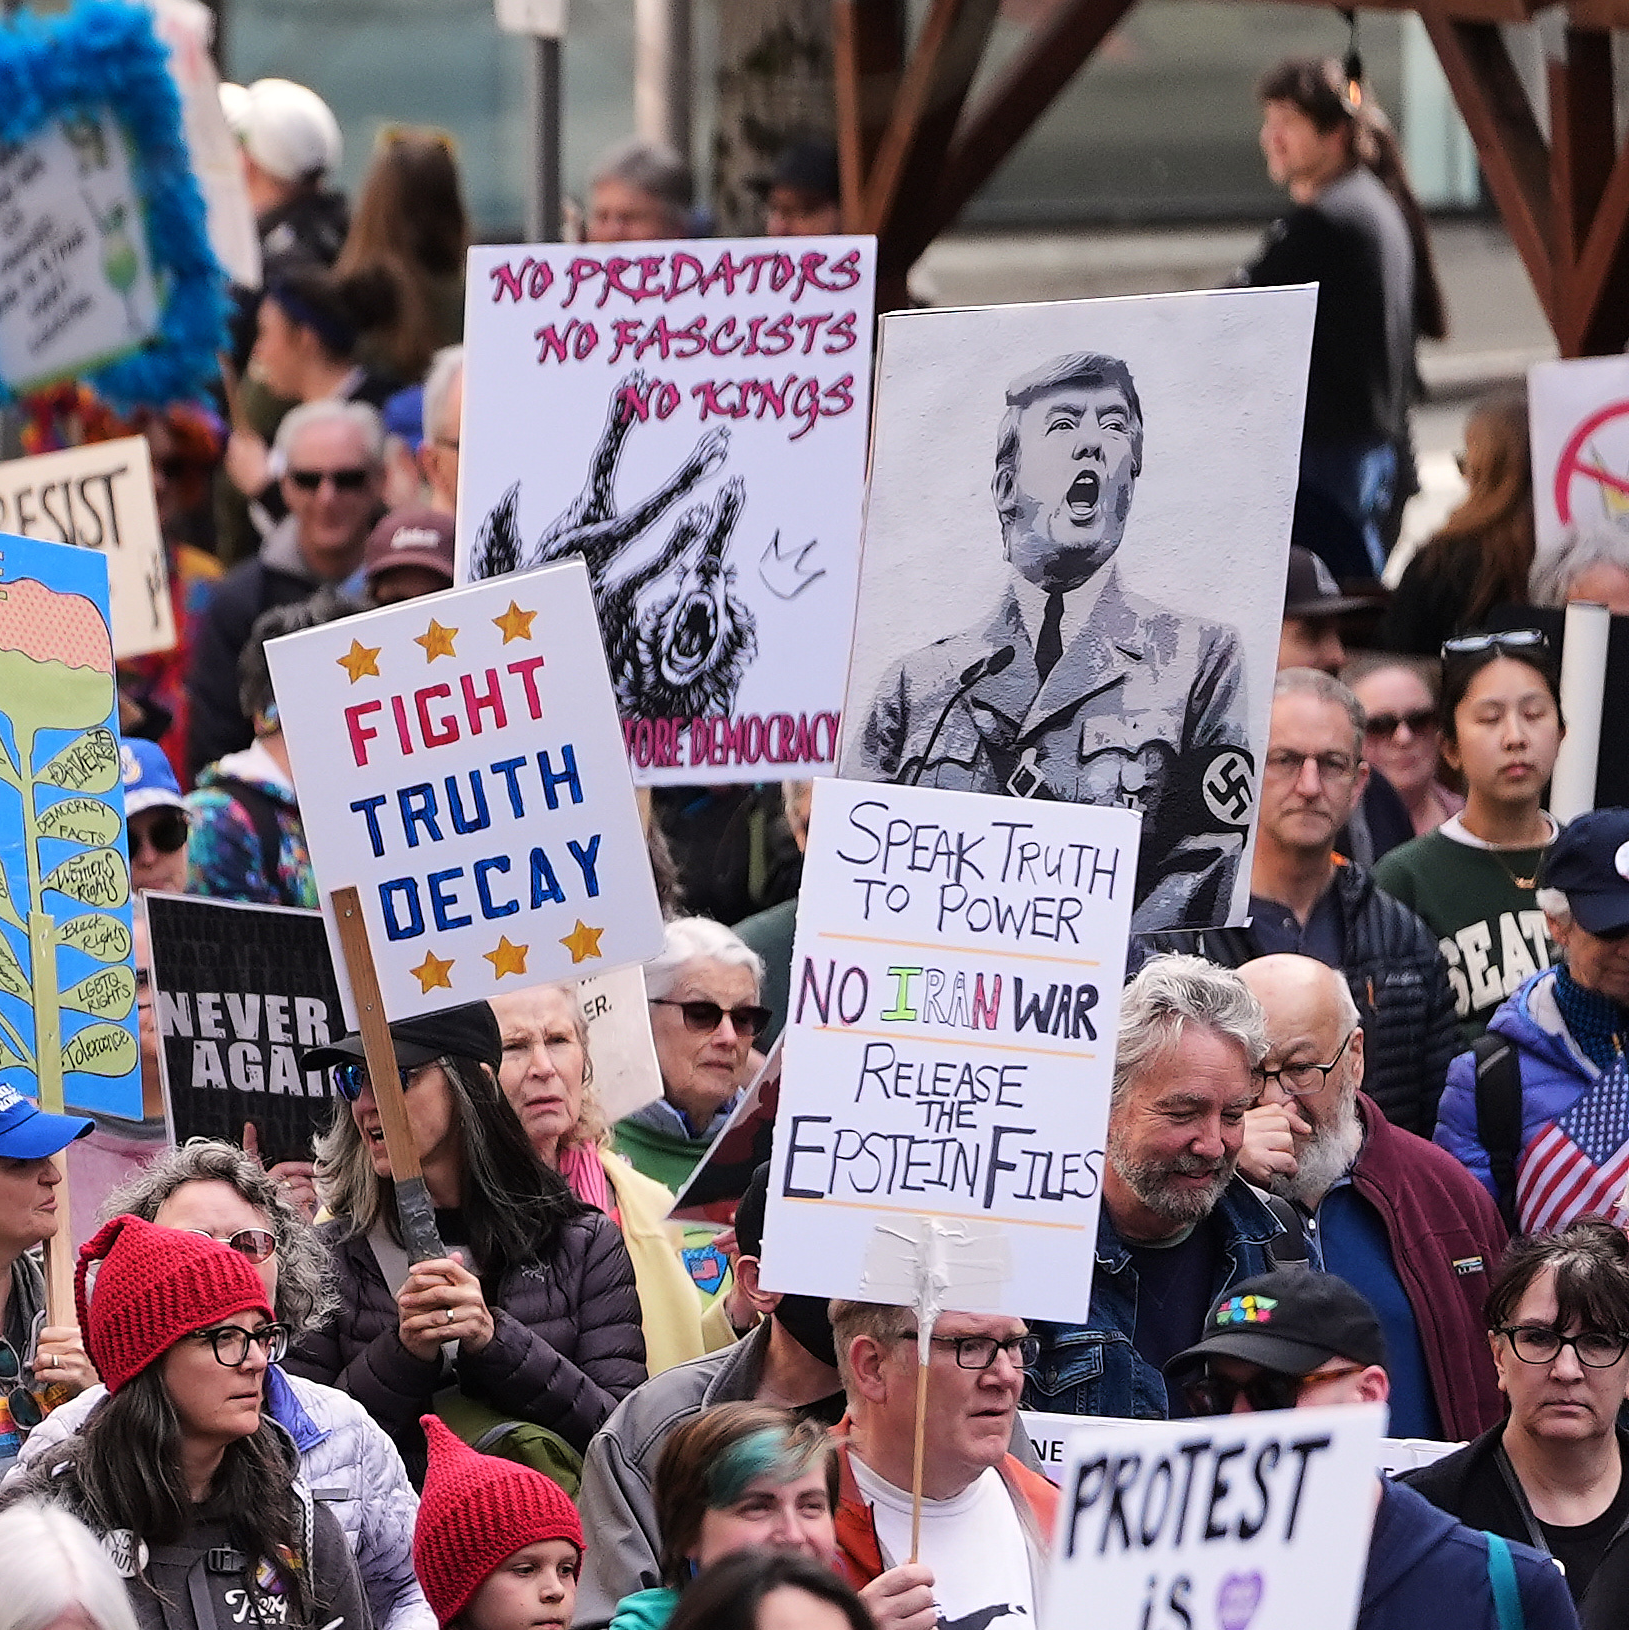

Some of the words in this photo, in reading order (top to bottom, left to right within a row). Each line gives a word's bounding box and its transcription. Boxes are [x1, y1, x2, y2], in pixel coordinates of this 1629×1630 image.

[490, 255, 554, 303] NO
[561, 248, 862, 309] PREDATORS
[534, 317, 599, 365] NO
[607, 310, 859, 365] FASCISTS
[616, 374, 681, 424] NO
[691, 373, 855, 443] KINGS
[343, 654, 547, 769] FIGHT
[690, 709, 841, 767] DEMOCRACY
[37, 803, 107, 834] DEMOCRACY
[348, 741, 585, 858] TRUTH
[59, 825, 106, 845] FACTS
[835, 800, 991, 886] SPEAK
[990, 820, 1122, 902] TRUTH
[377, 832, 603, 944] DECAY
[852, 876, 912, 922] TO
[935, 880, 1085, 946] POWER
[61, 916, 105, 940] Black
[82, 926, 127, 956] Rights
[77, 972, 120, 1001] LGBTQ
[88, 984, 131, 1012] RIGHTS
[157, 990, 333, 1040] NEVER
[794, 951, 870, 1030] NO
[879, 964, 1004, 1033] IRAN
[1012, 974, 1099, 1044] WAR
[61, 1030, 129, 1069] Tolerance
[852, 1039, 1029, 1110] RELEASE
[915, 1096, 978, 1132] THE
[781, 1113, 980, 1201] EPSTEIN
[983, 1123, 1103, 1210] FILES
[1065, 1432, 1332, 1560] PROTEST
